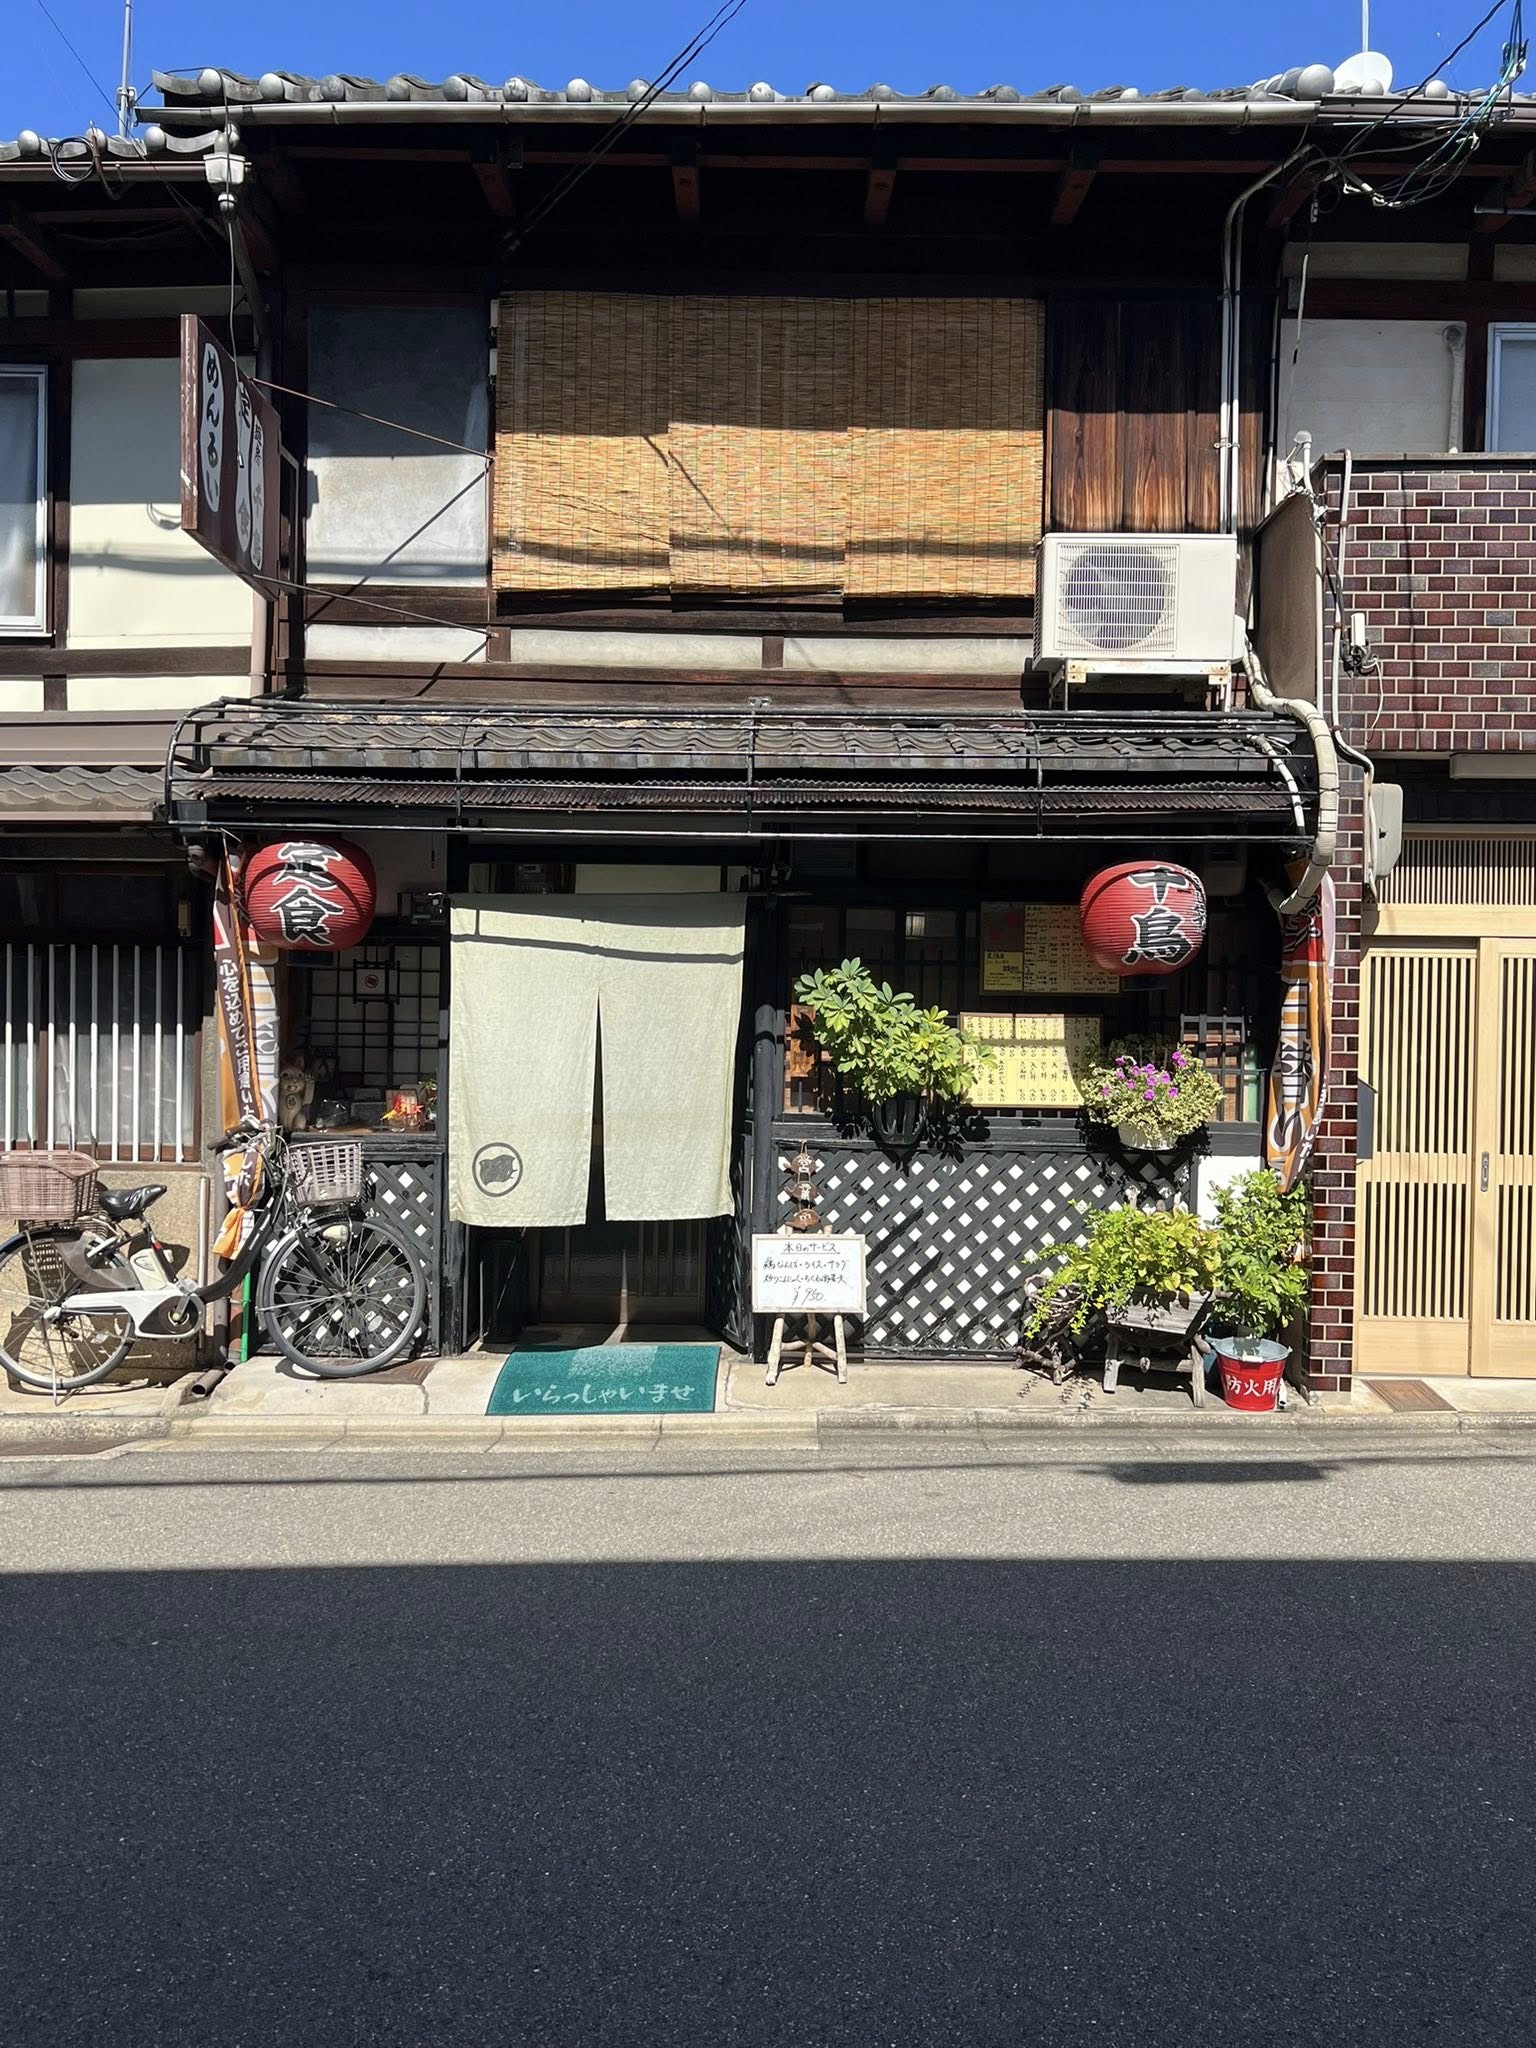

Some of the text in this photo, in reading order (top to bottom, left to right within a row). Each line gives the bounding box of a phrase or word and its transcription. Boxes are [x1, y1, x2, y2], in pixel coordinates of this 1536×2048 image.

[206, 349, 220, 503] めんるい
[269, 842, 344, 946] 定食
[1121, 864, 1193, 966] 千鳥
[784, 1241, 837, 1254] 本日のサービス
[512, 1383, 696, 1404] いらっしゃいませ
[1225, 1373, 1278, 1397] 防火用
